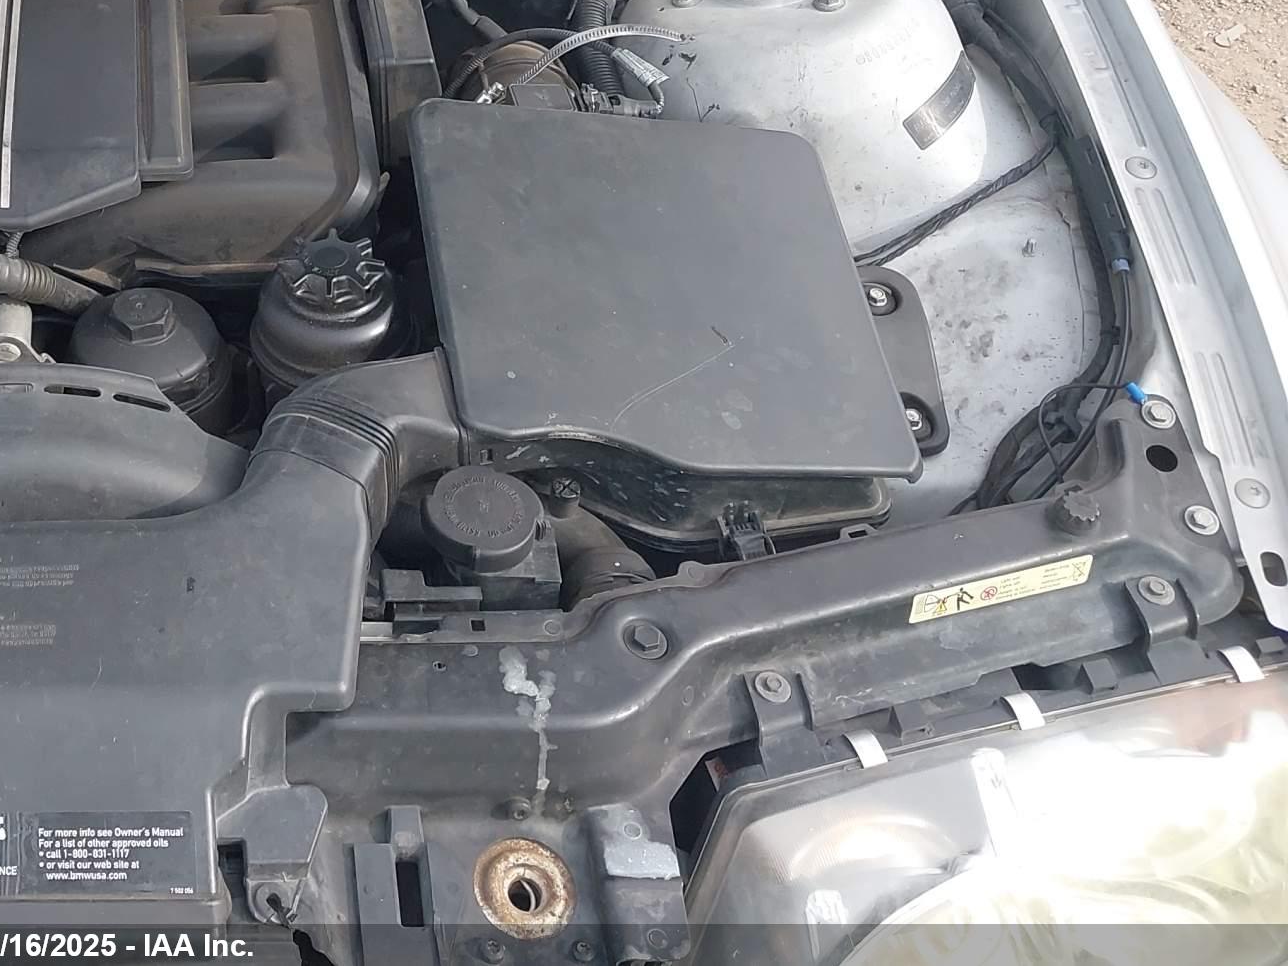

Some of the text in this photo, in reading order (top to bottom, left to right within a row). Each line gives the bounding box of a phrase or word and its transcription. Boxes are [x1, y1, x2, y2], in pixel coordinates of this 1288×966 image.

[38, 827, 184, 837] For more info see Owner's Manual
[38, 839, 53, 848] For
[62, 838, 76, 848] list
[77, 838, 87, 848] of
[88, 838, 110, 848] other
[111, 838, 152, 849] approved
[153, 838, 169, 848] oils
[46, 849, 130, 858] call 1-800-831-1117
[46, 859, 140, 869] or visit our web site at
[46, 870, 128, 880] www.bmwusa.com
